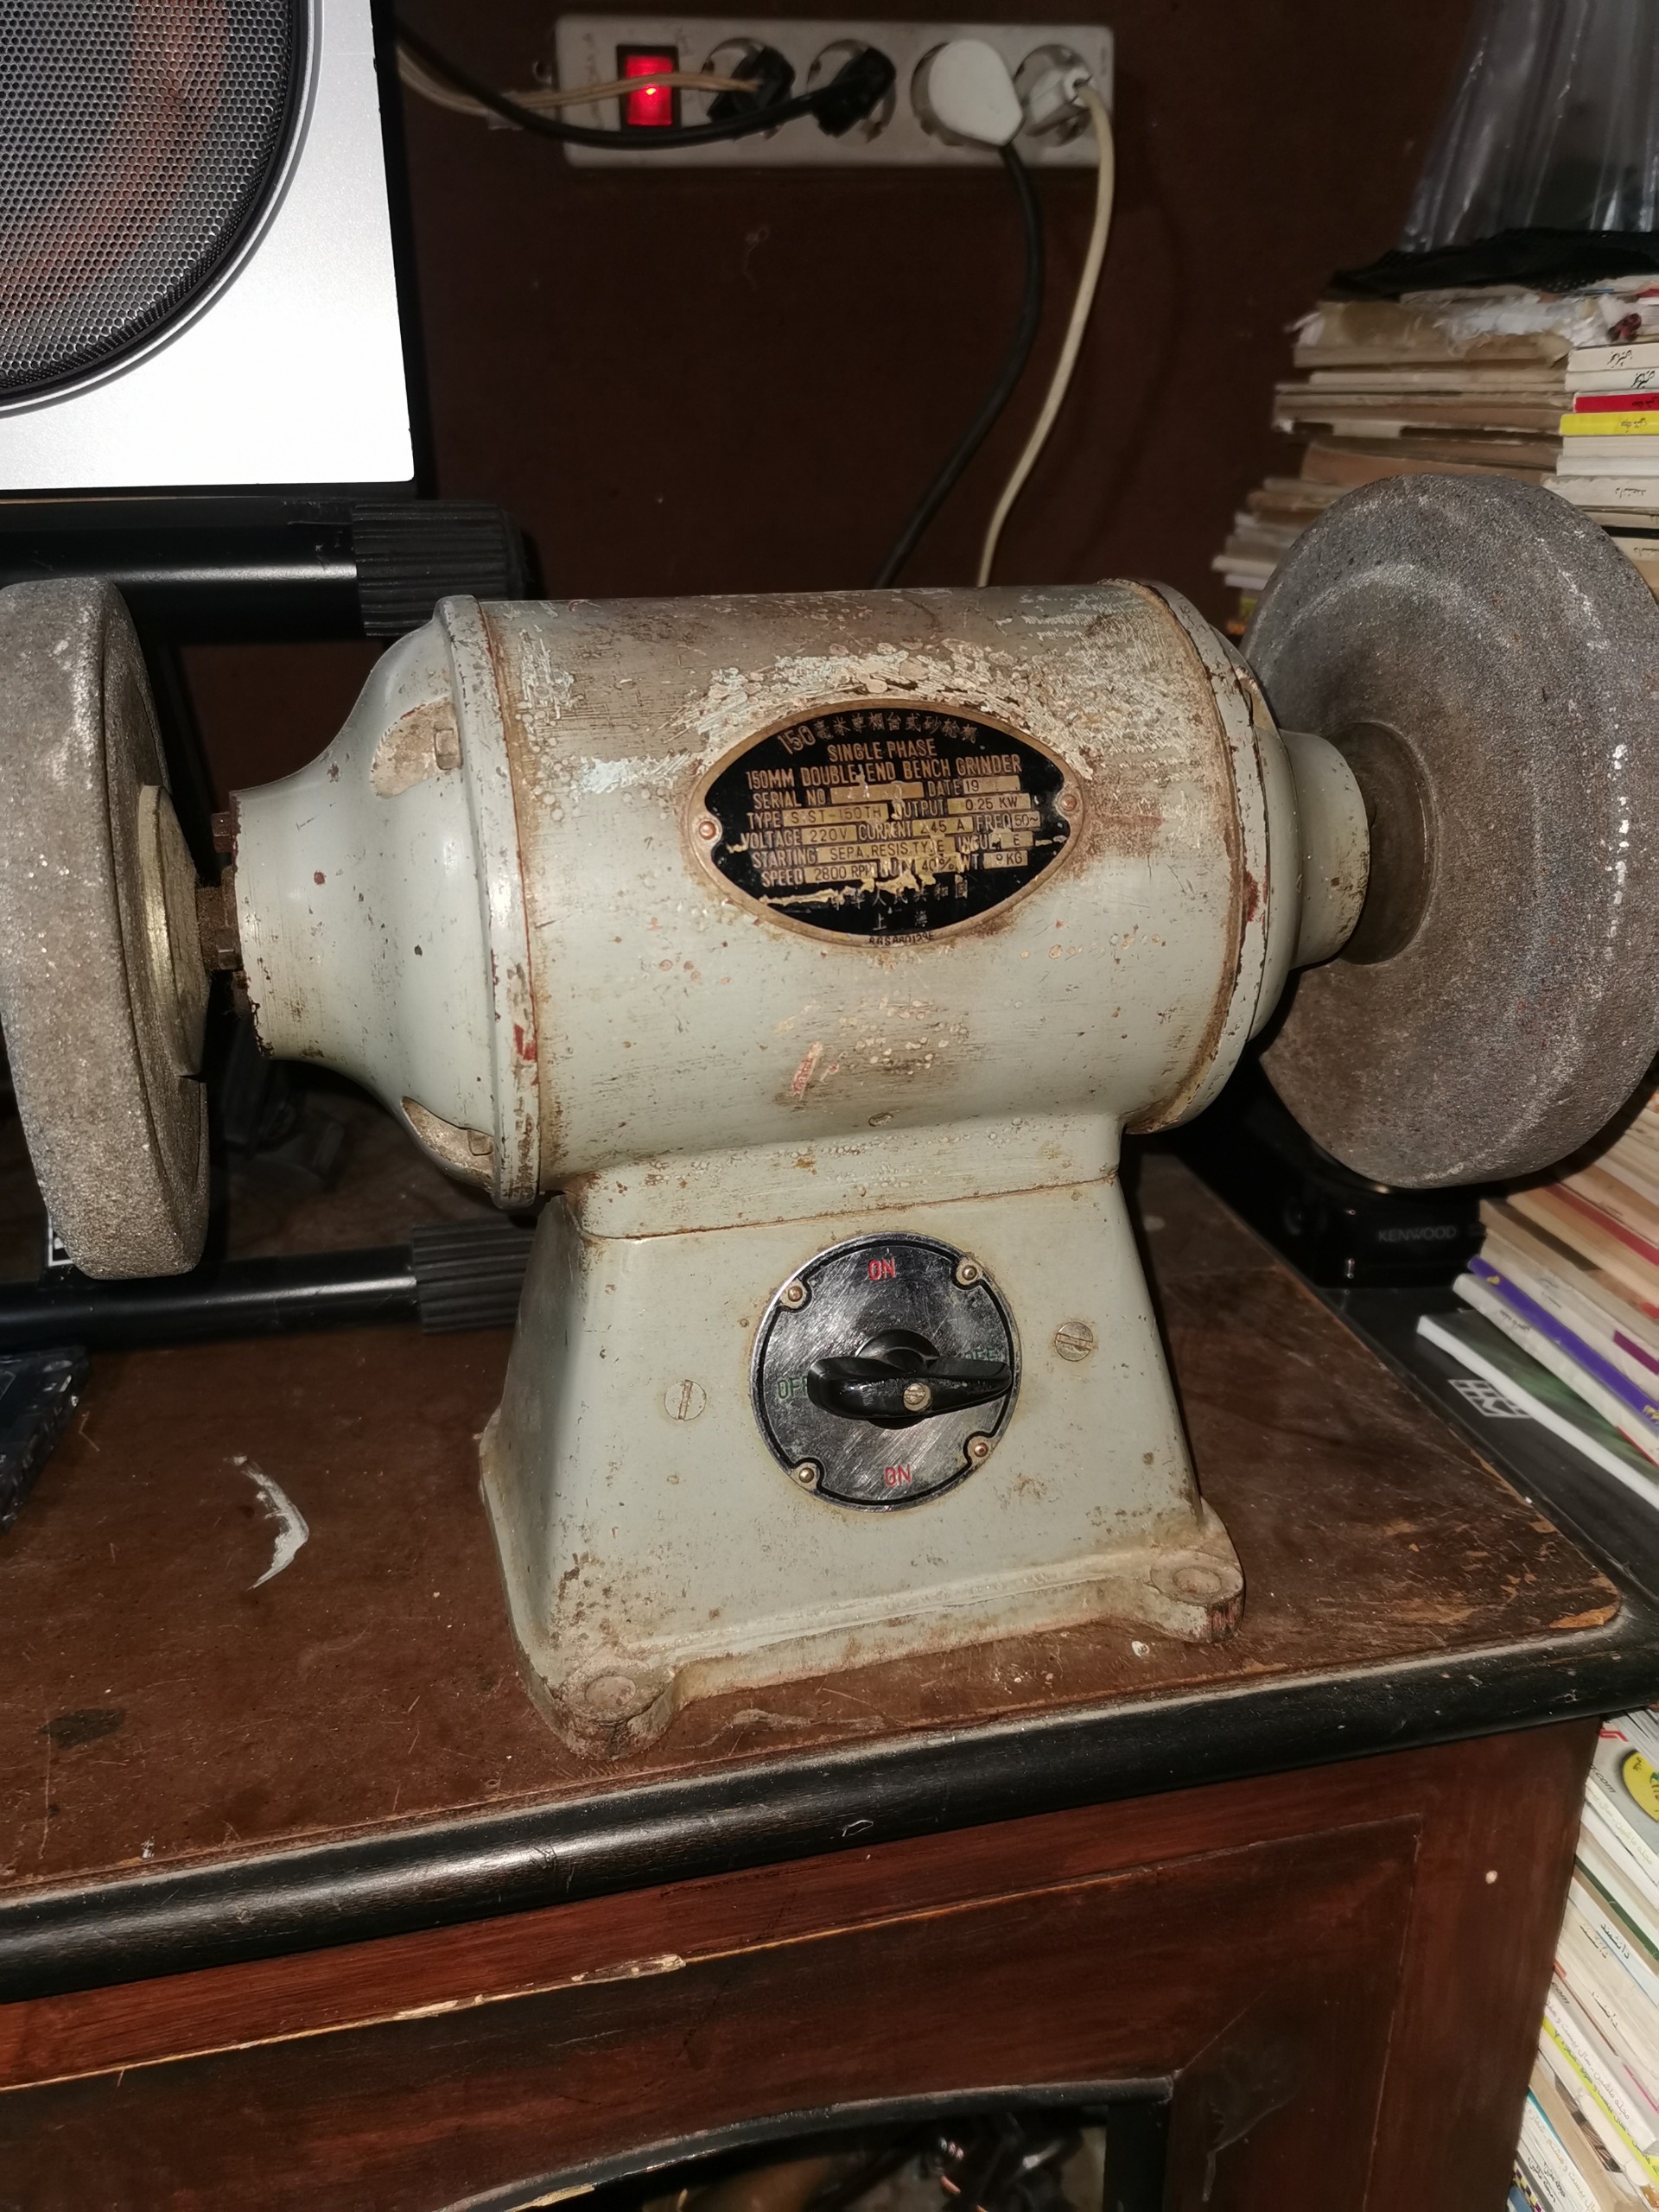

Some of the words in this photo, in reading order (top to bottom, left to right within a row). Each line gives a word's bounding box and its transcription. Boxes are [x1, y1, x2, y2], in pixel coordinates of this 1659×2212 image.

[827, 741, 883, 763] SINGLE
[887, 738, 938, 759] PHASE
[747, 767, 795, 790] 150MM
[800, 764, 856, 787] DOUBLE
[866, 762, 896, 783] END
[902, 758, 951, 780] BENCH
[956, 754, 1022, 777] GRINDER
[753, 789, 802, 810] SERIAL
[927, 779, 962, 798] DATE
[747, 811, 782, 830] TYPE
[791, 804, 881, 824] SST-150TH
[965, 798, 994, 810] 0.25
[1000, 796, 1018, 808] KW
[741, 830, 802, 849] VOLTAGE
[810, 827, 848, 842] 220V
[859, 821, 912, 841] CURRENT
[957, 821, 965, 831] A
[753, 848, 817, 868] STARTING
[1013, 835, 1020, 846] E
[761, 868, 804, 888] SPEED
[815, 866, 847, 881] 2800
[1007, 853, 1023, 865] KG
[1377, 1225, 1458, 1243] KENWOOD
[868, 1258, 895, 1281] ON
[884, 1465, 912, 1488] ON
[1599, 1921, 1632, 1959] دانشمند
[1577, 2048, 1593, 2067] سال
[1593, 2071, 1617, 2100] ماشین
[1611, 2097, 1631, 2121] مجله
